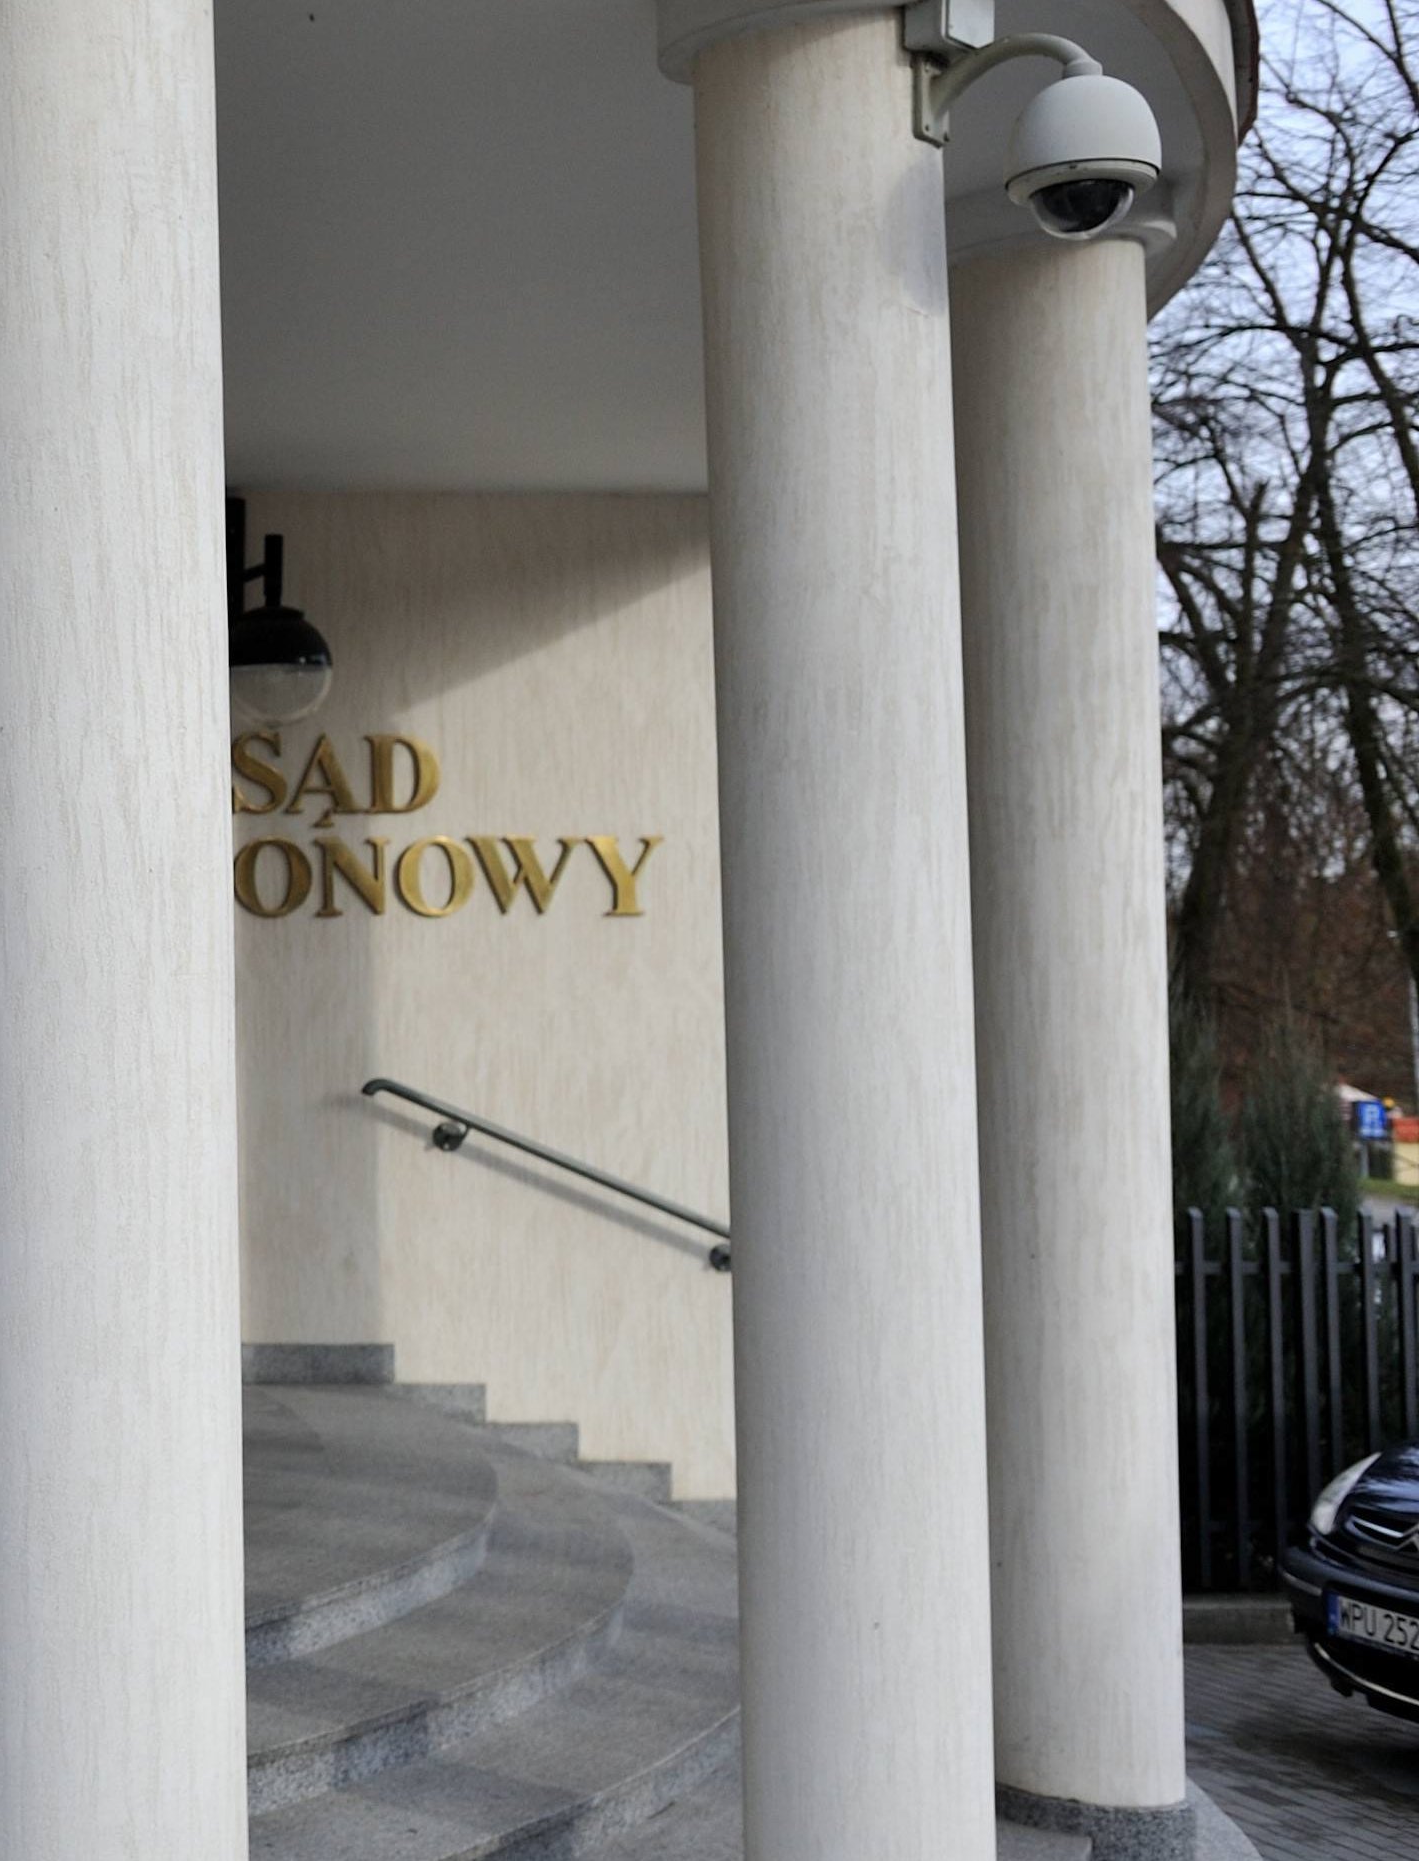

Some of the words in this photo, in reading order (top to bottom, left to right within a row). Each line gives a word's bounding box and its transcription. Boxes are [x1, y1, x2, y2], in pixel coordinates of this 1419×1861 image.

[231, 731, 441, 829] SĄD
[234, 834, 665, 919] ONOWY
[1339, 1597, 1377, 1637] WPU
[1383, 1612, 1419, 1651] 252
